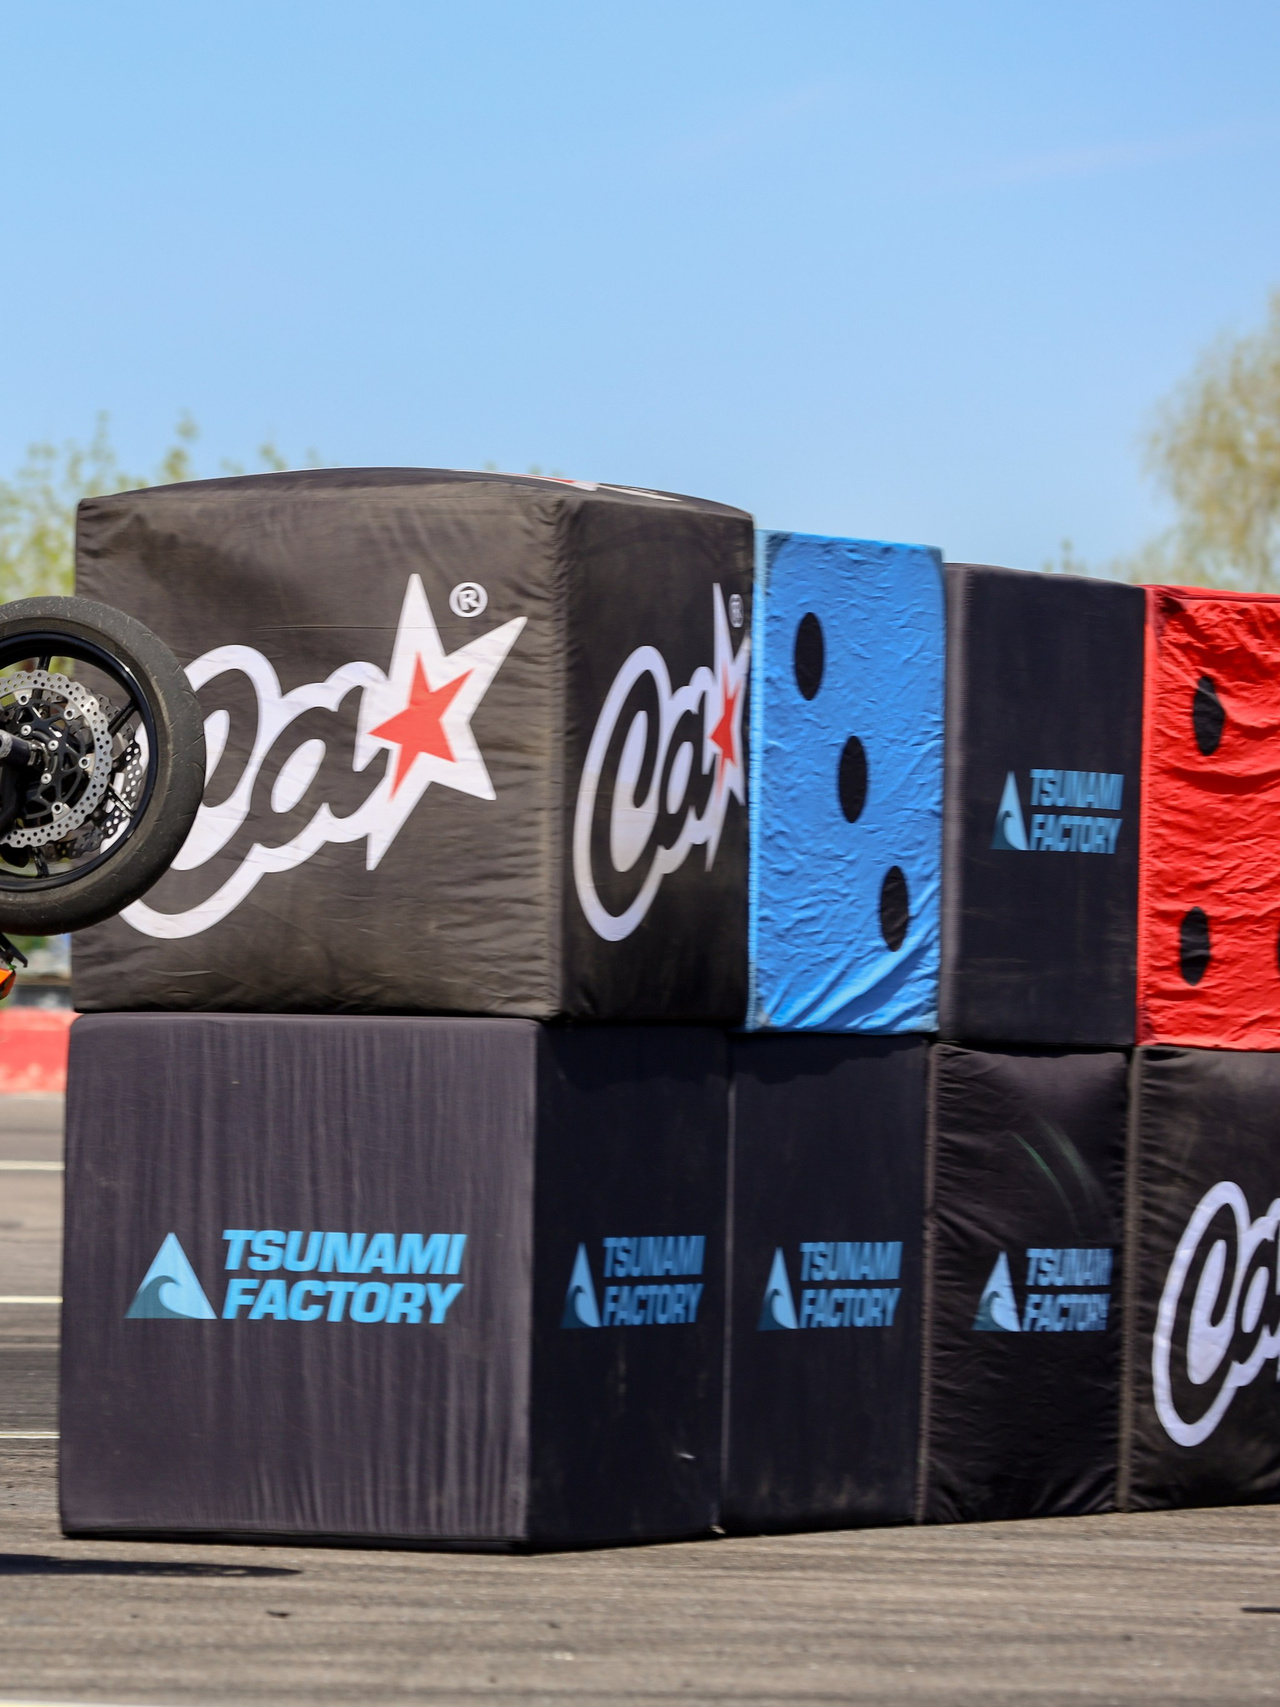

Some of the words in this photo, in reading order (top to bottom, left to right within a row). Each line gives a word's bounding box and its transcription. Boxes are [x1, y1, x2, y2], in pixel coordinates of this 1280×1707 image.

[1030, 768, 1125, 810] TSUNAMI
[1029, 814, 1123, 854] FACTORY
[222, 1229, 468, 1275] TSUNAMI
[603, 1235, 706, 1277] TSUNAMI
[800, 1241, 903, 1281] TSUNAMI
[222, 1278, 464, 1324] FACTORY
[602, 1283, 705, 1327] FACTORY
[800, 1287, 902, 1329] FACTORY
